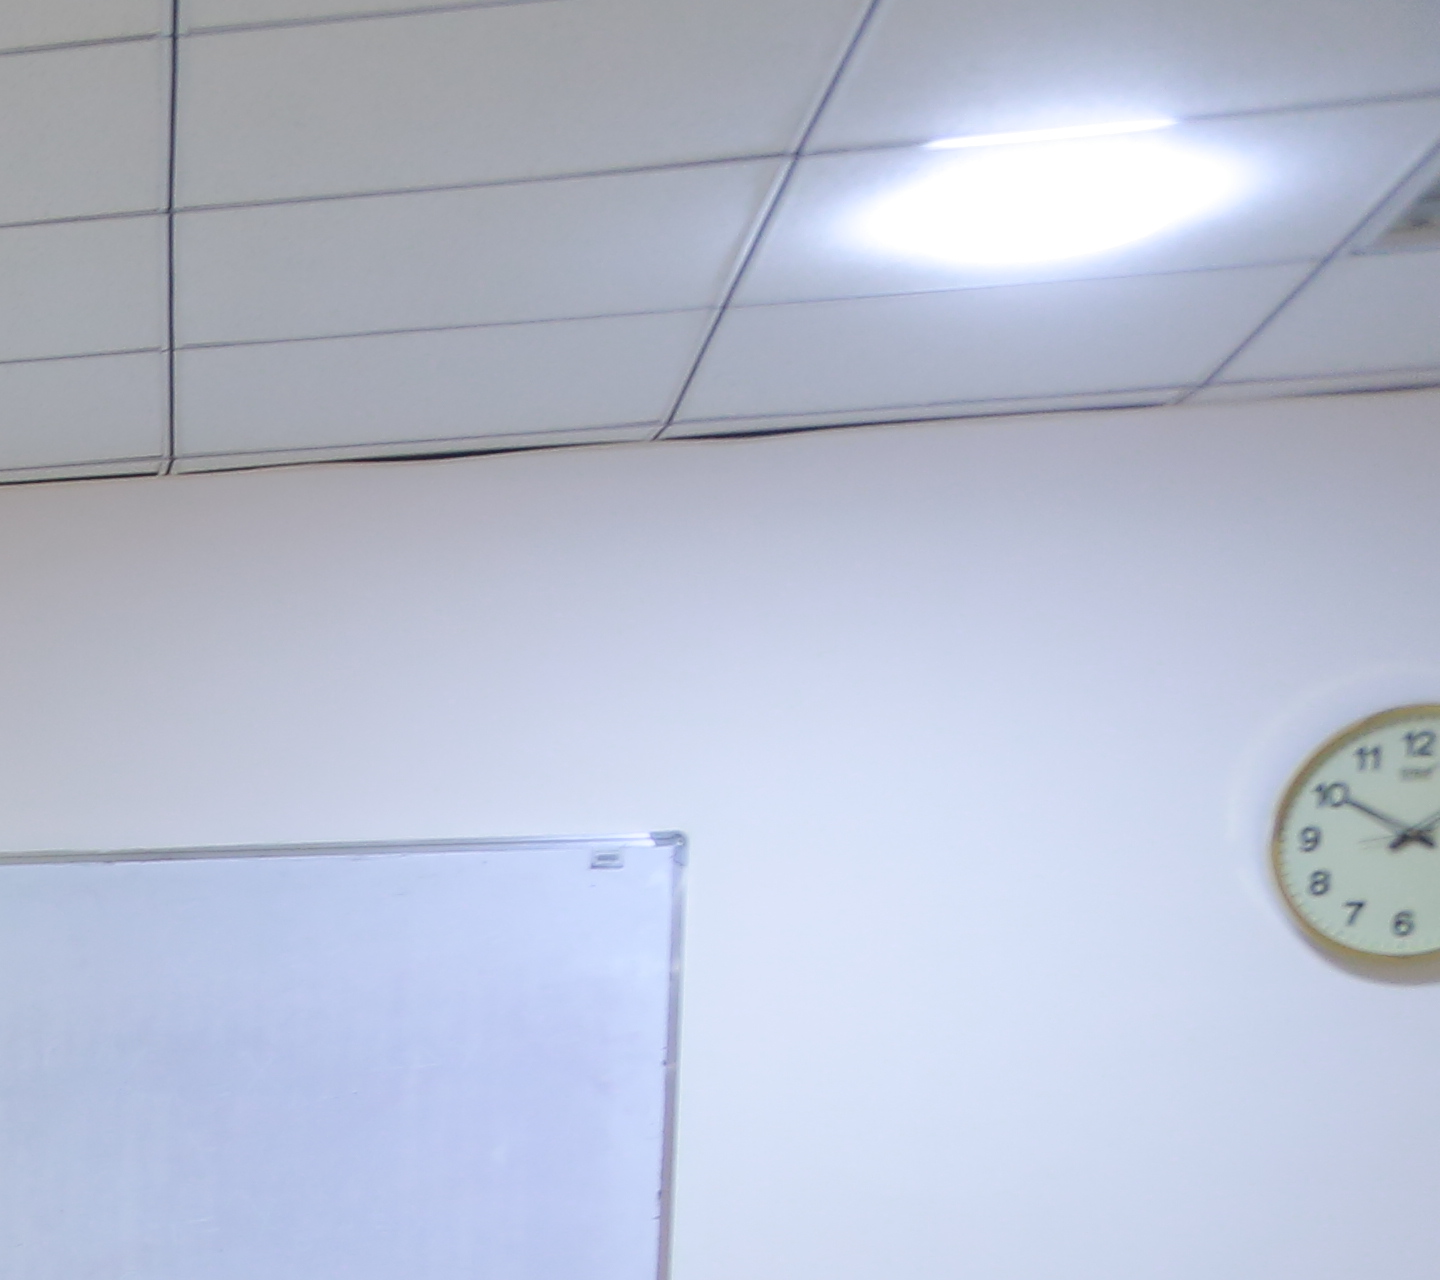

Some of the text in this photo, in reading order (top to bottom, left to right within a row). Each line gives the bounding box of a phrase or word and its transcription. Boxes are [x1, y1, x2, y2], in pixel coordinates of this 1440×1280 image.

[1403, 731, 1436, 757] 12
[1354, 745, 1382, 771] 11
[1312, 781, 1350, 808] 10
[1299, 825, 1322, 852] 9
[1309, 870, 1331, 896] 8
[1343, 901, 1367, 926] 7
[1391, 909, 1415, 937] 6
